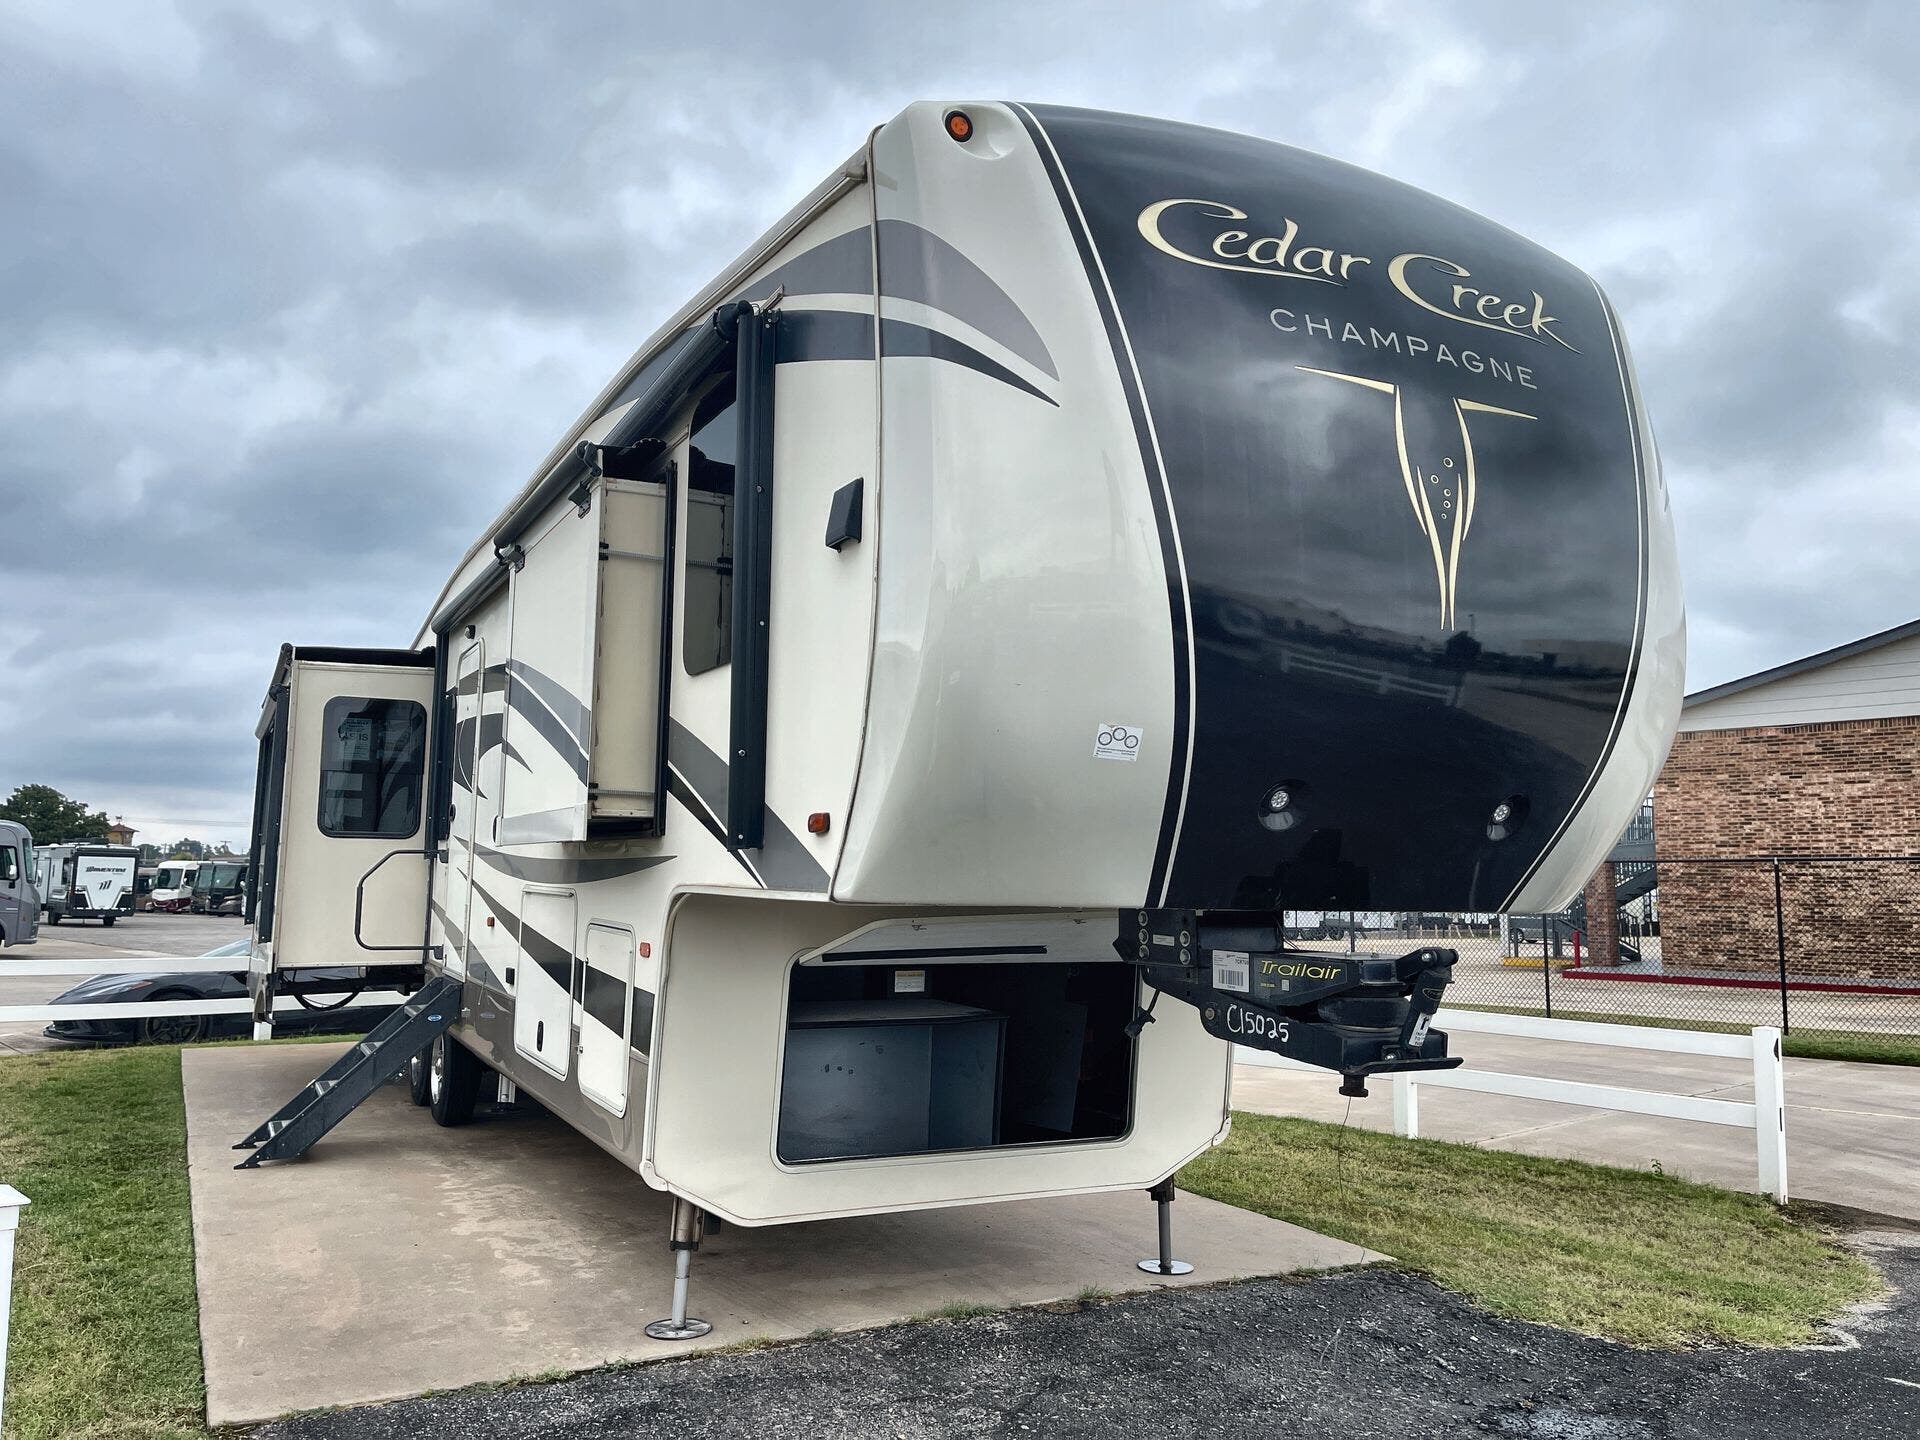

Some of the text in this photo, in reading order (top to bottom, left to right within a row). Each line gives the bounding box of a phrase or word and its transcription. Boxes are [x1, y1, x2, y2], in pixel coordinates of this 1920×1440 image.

[1137, 198, 1584, 354] Cedar Creek
[1269, 308, 1538, 389] CHAMPAGNE
[1261, 960, 1342, 980] Trailair
